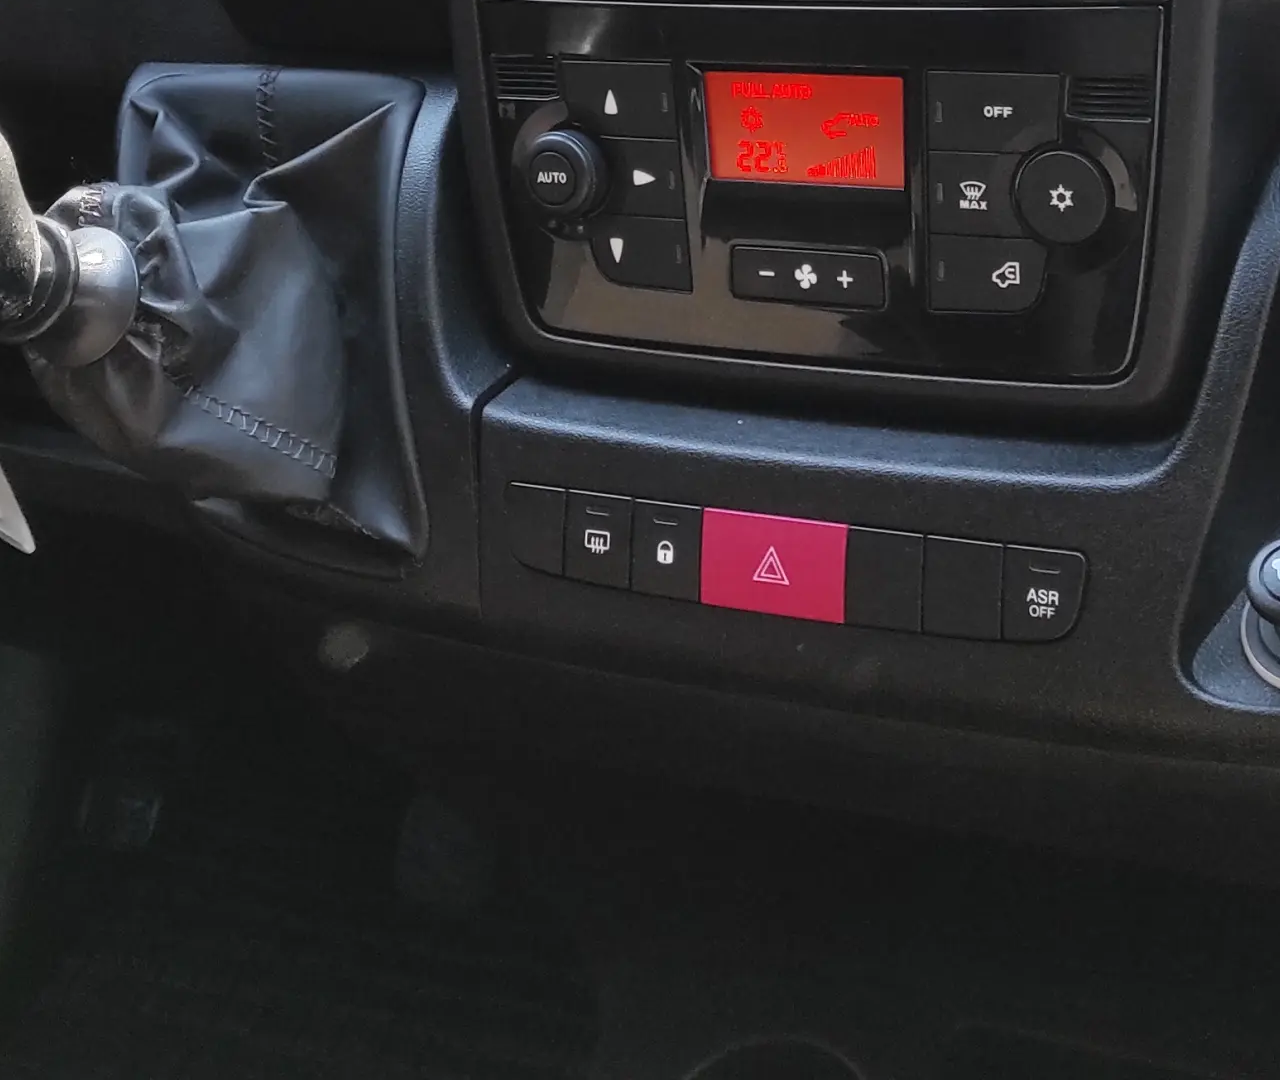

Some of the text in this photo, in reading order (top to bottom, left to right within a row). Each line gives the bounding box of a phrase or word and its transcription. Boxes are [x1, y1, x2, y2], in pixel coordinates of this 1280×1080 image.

[732, 82, 812, 100] FULL AUTO
[983, 105, 1013, 118] OFF
[536, 171, 568, 184] AUTO
[959, 200, 988, 210] MAX
[1026, 587, 1060, 606] ASR
[1028, 604, 1056, 619] OFF
